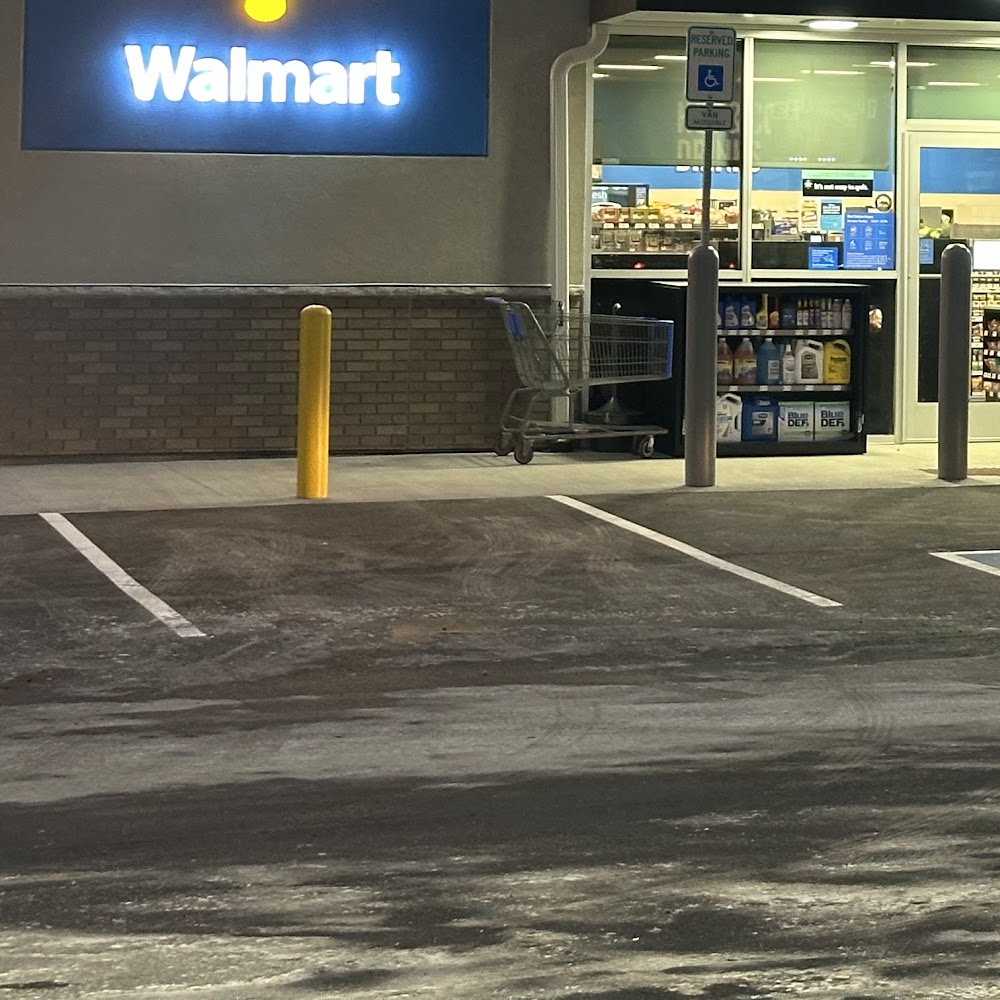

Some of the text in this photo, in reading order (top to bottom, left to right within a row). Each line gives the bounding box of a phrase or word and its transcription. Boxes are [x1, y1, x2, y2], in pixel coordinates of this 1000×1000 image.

[690, 34, 733, 46] RESERVED
[693, 47, 730, 58] PARKING
[124, 44, 400, 106] Walmart
[701, 110, 719, 118] VAN
[821, 410, 844, 418] Blue
